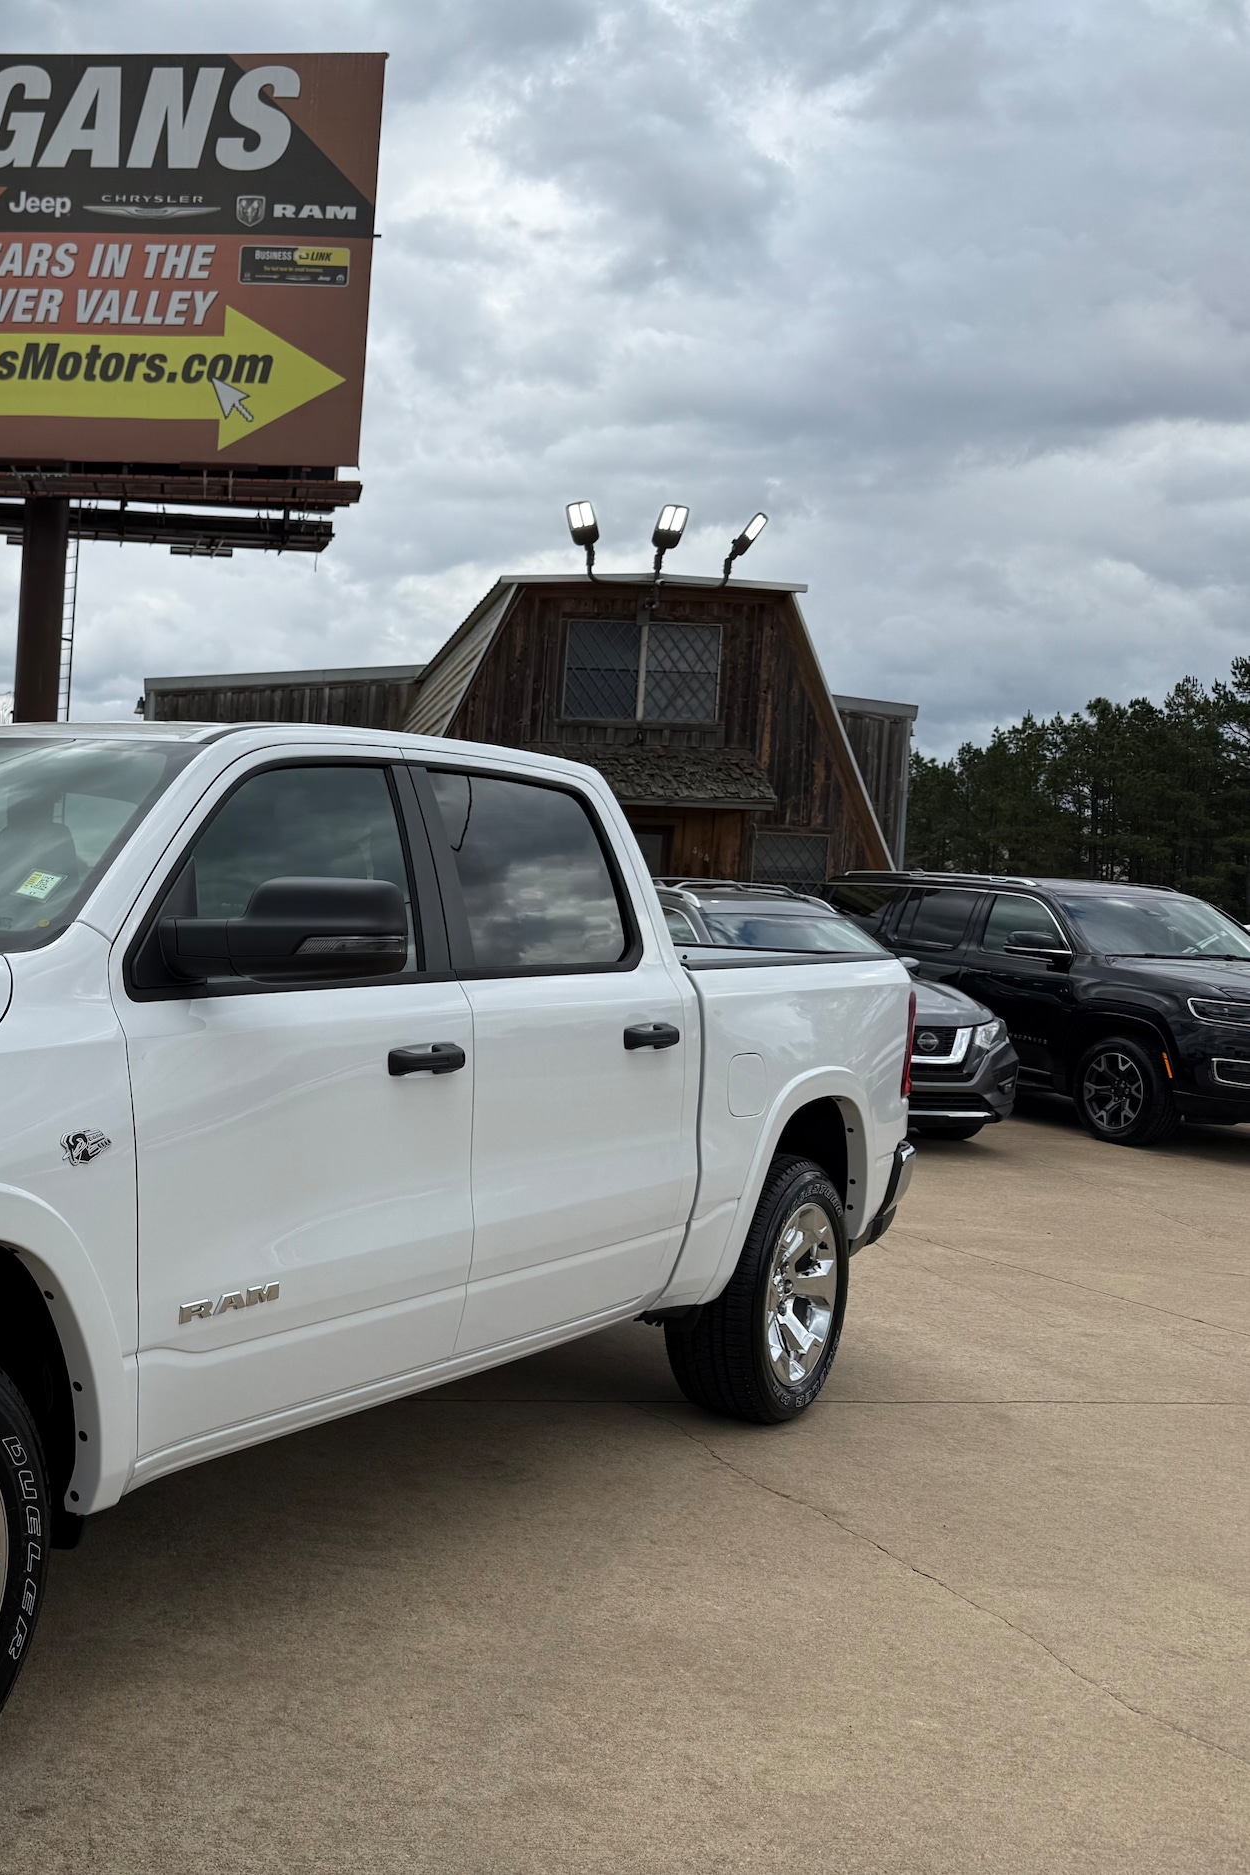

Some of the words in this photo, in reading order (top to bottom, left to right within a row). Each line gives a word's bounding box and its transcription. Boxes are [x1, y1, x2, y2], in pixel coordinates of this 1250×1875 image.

[9, 191, 72, 218] Jeep
[101, 194, 204, 204] CHRYSLER
[273, 204, 357, 220] RAM
[87, 243, 132, 280] IN
[141, 244, 217, 281] THE
[255, 250, 292, 260] BUSINESS
[311, 252, 332, 262] LINK
[75, 288, 220, 327] VALLEY
[178, 1280, 280, 1325] RAM
[2, 1436, 41, 1660] DUELER
